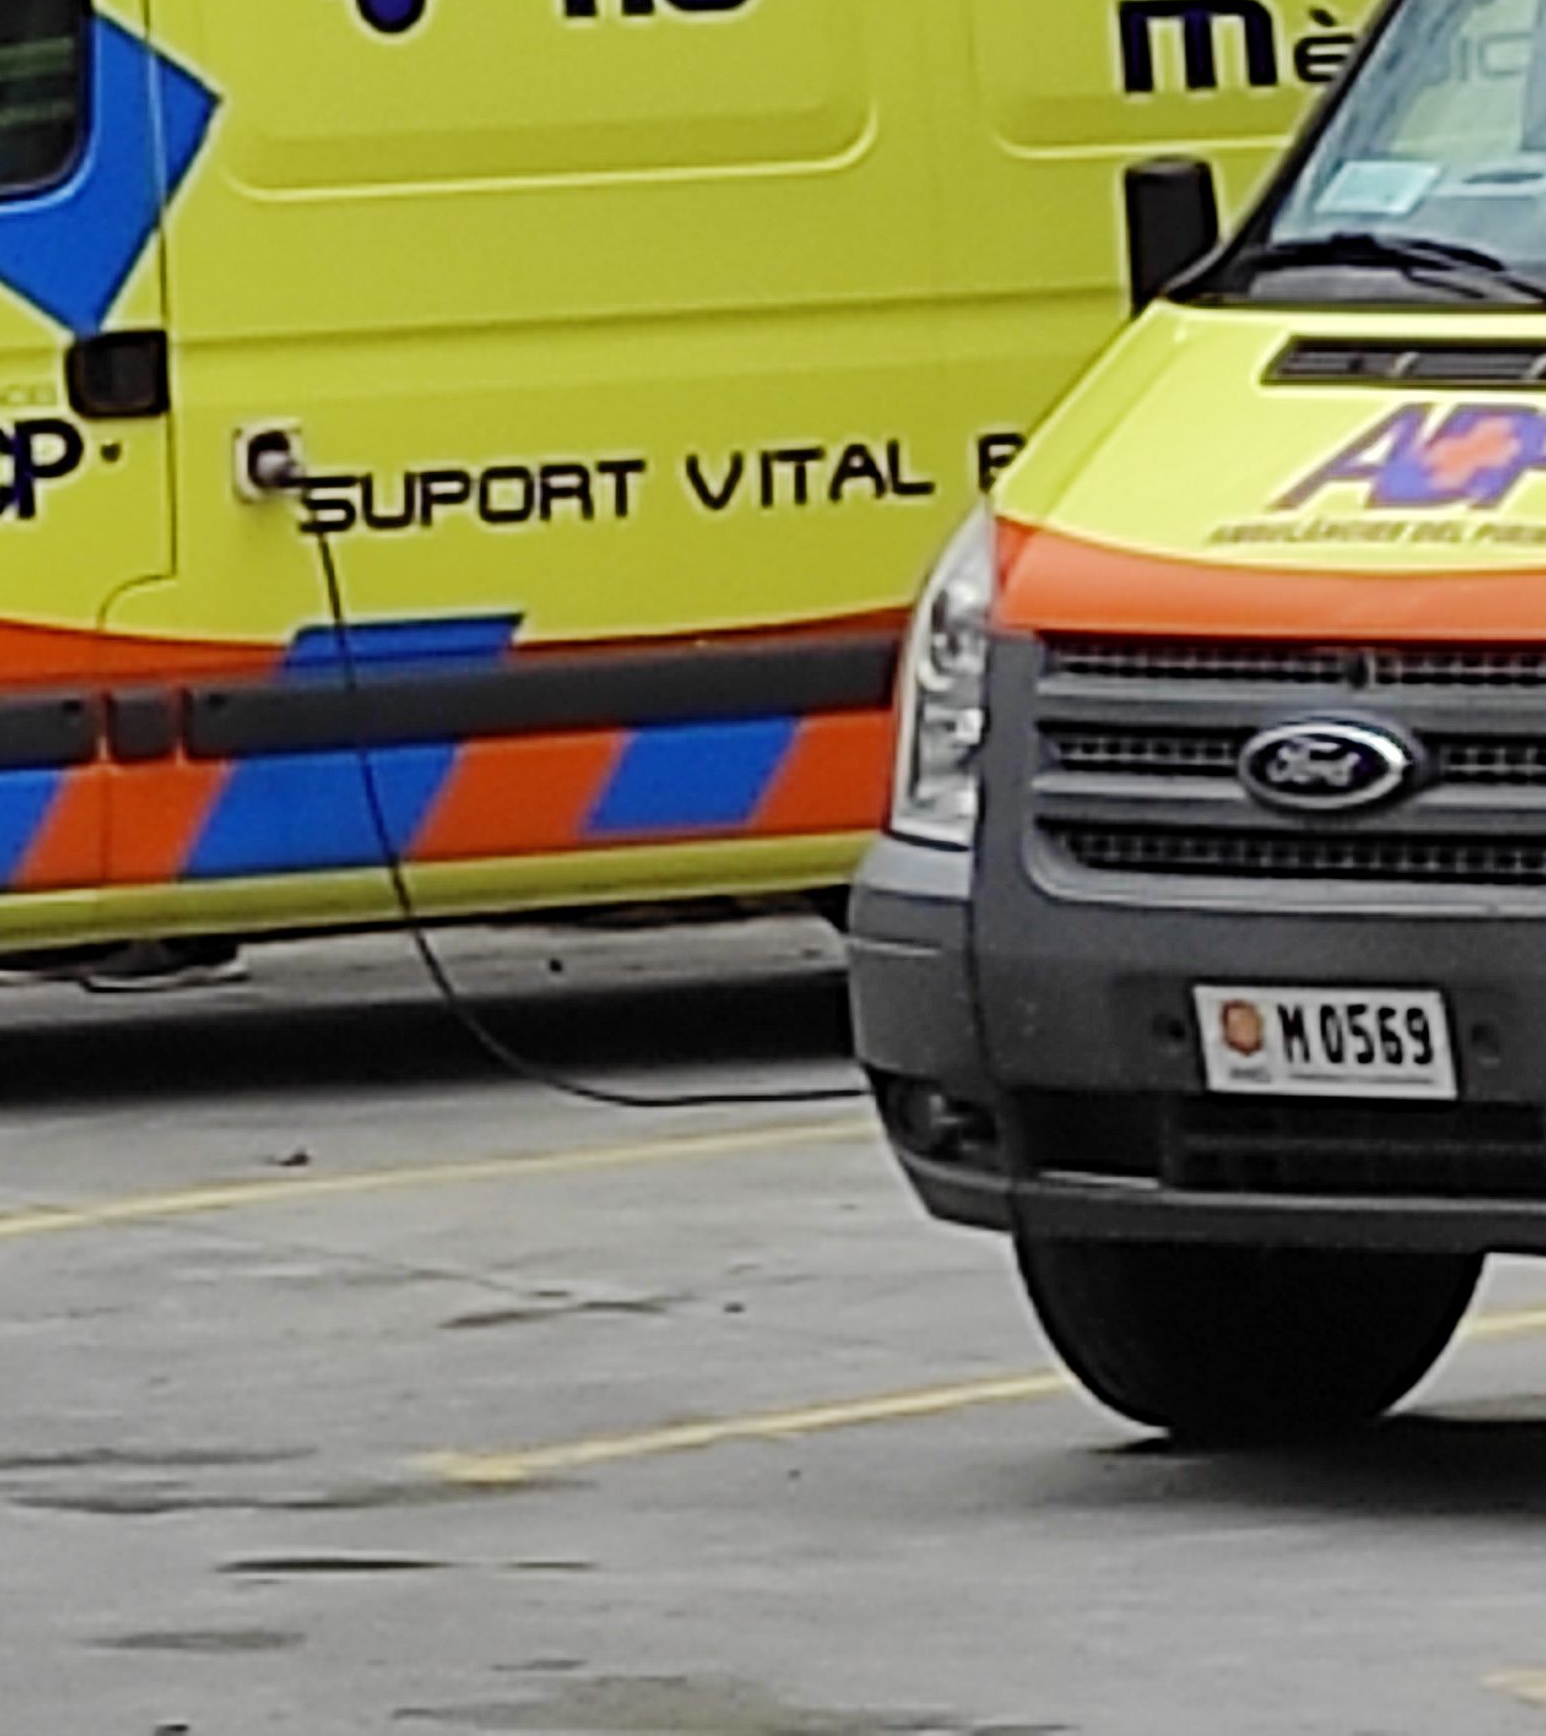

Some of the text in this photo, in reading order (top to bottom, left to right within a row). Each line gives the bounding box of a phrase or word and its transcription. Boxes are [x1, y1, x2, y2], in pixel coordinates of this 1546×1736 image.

[297, 460, 646, 534] SUPORT
[686, 439, 935, 510] VITAL
[1278, 1003, 1434, 1065] M0569
